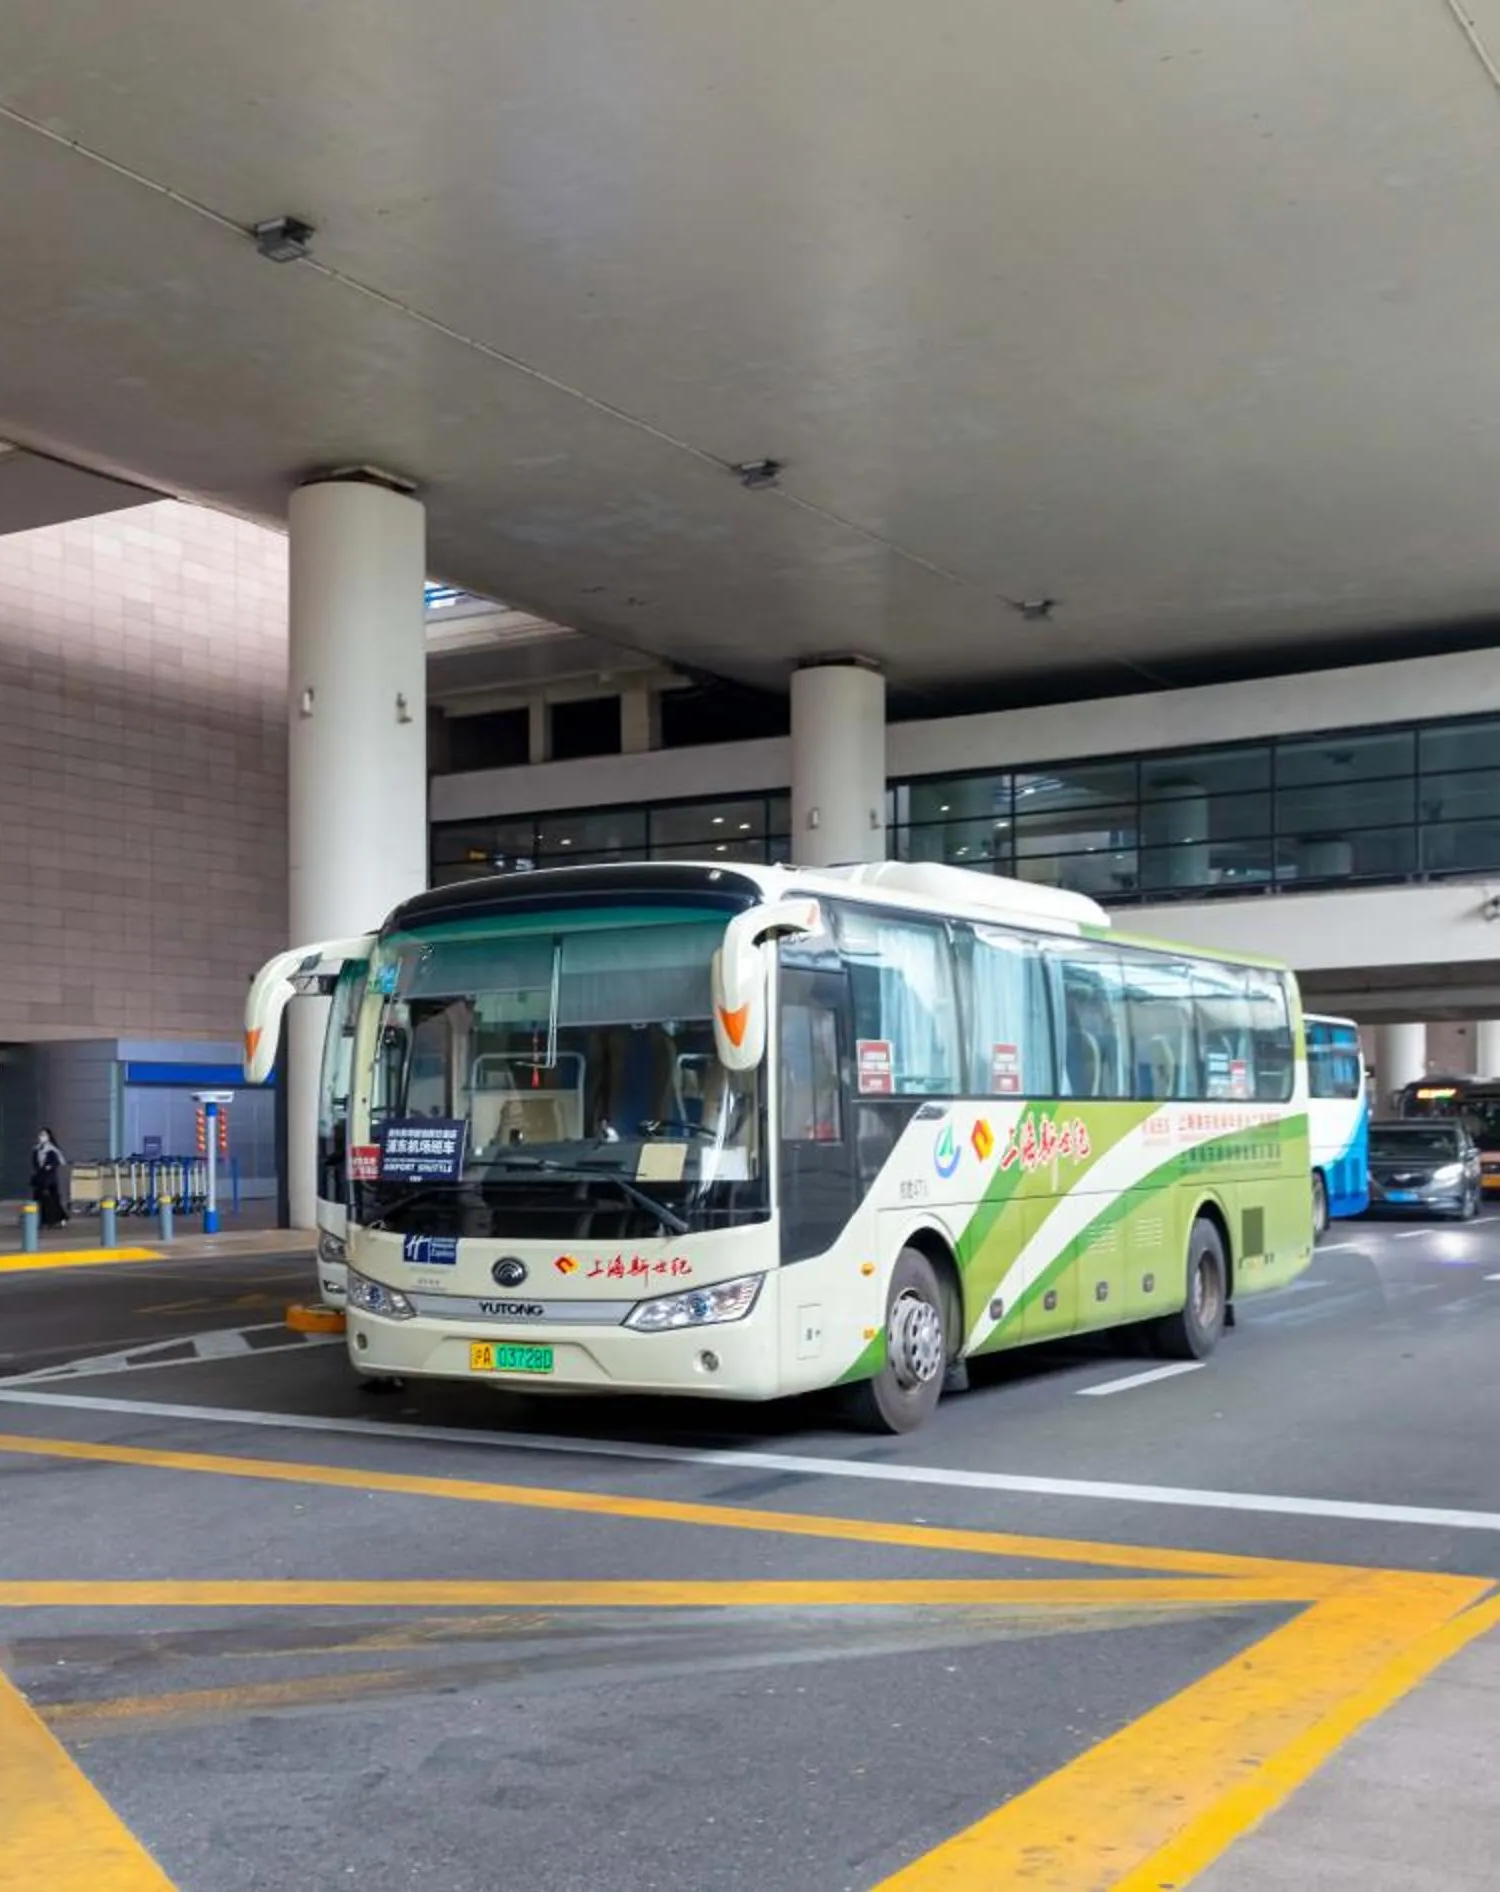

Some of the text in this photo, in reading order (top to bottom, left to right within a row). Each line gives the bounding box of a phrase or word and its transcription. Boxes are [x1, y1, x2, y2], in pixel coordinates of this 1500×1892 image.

[383, 1162, 415, 1171] AIRPORT
[418, 1163, 453, 1173] SHUTTLE
[479, 1302, 544, 1316] YUTONG
